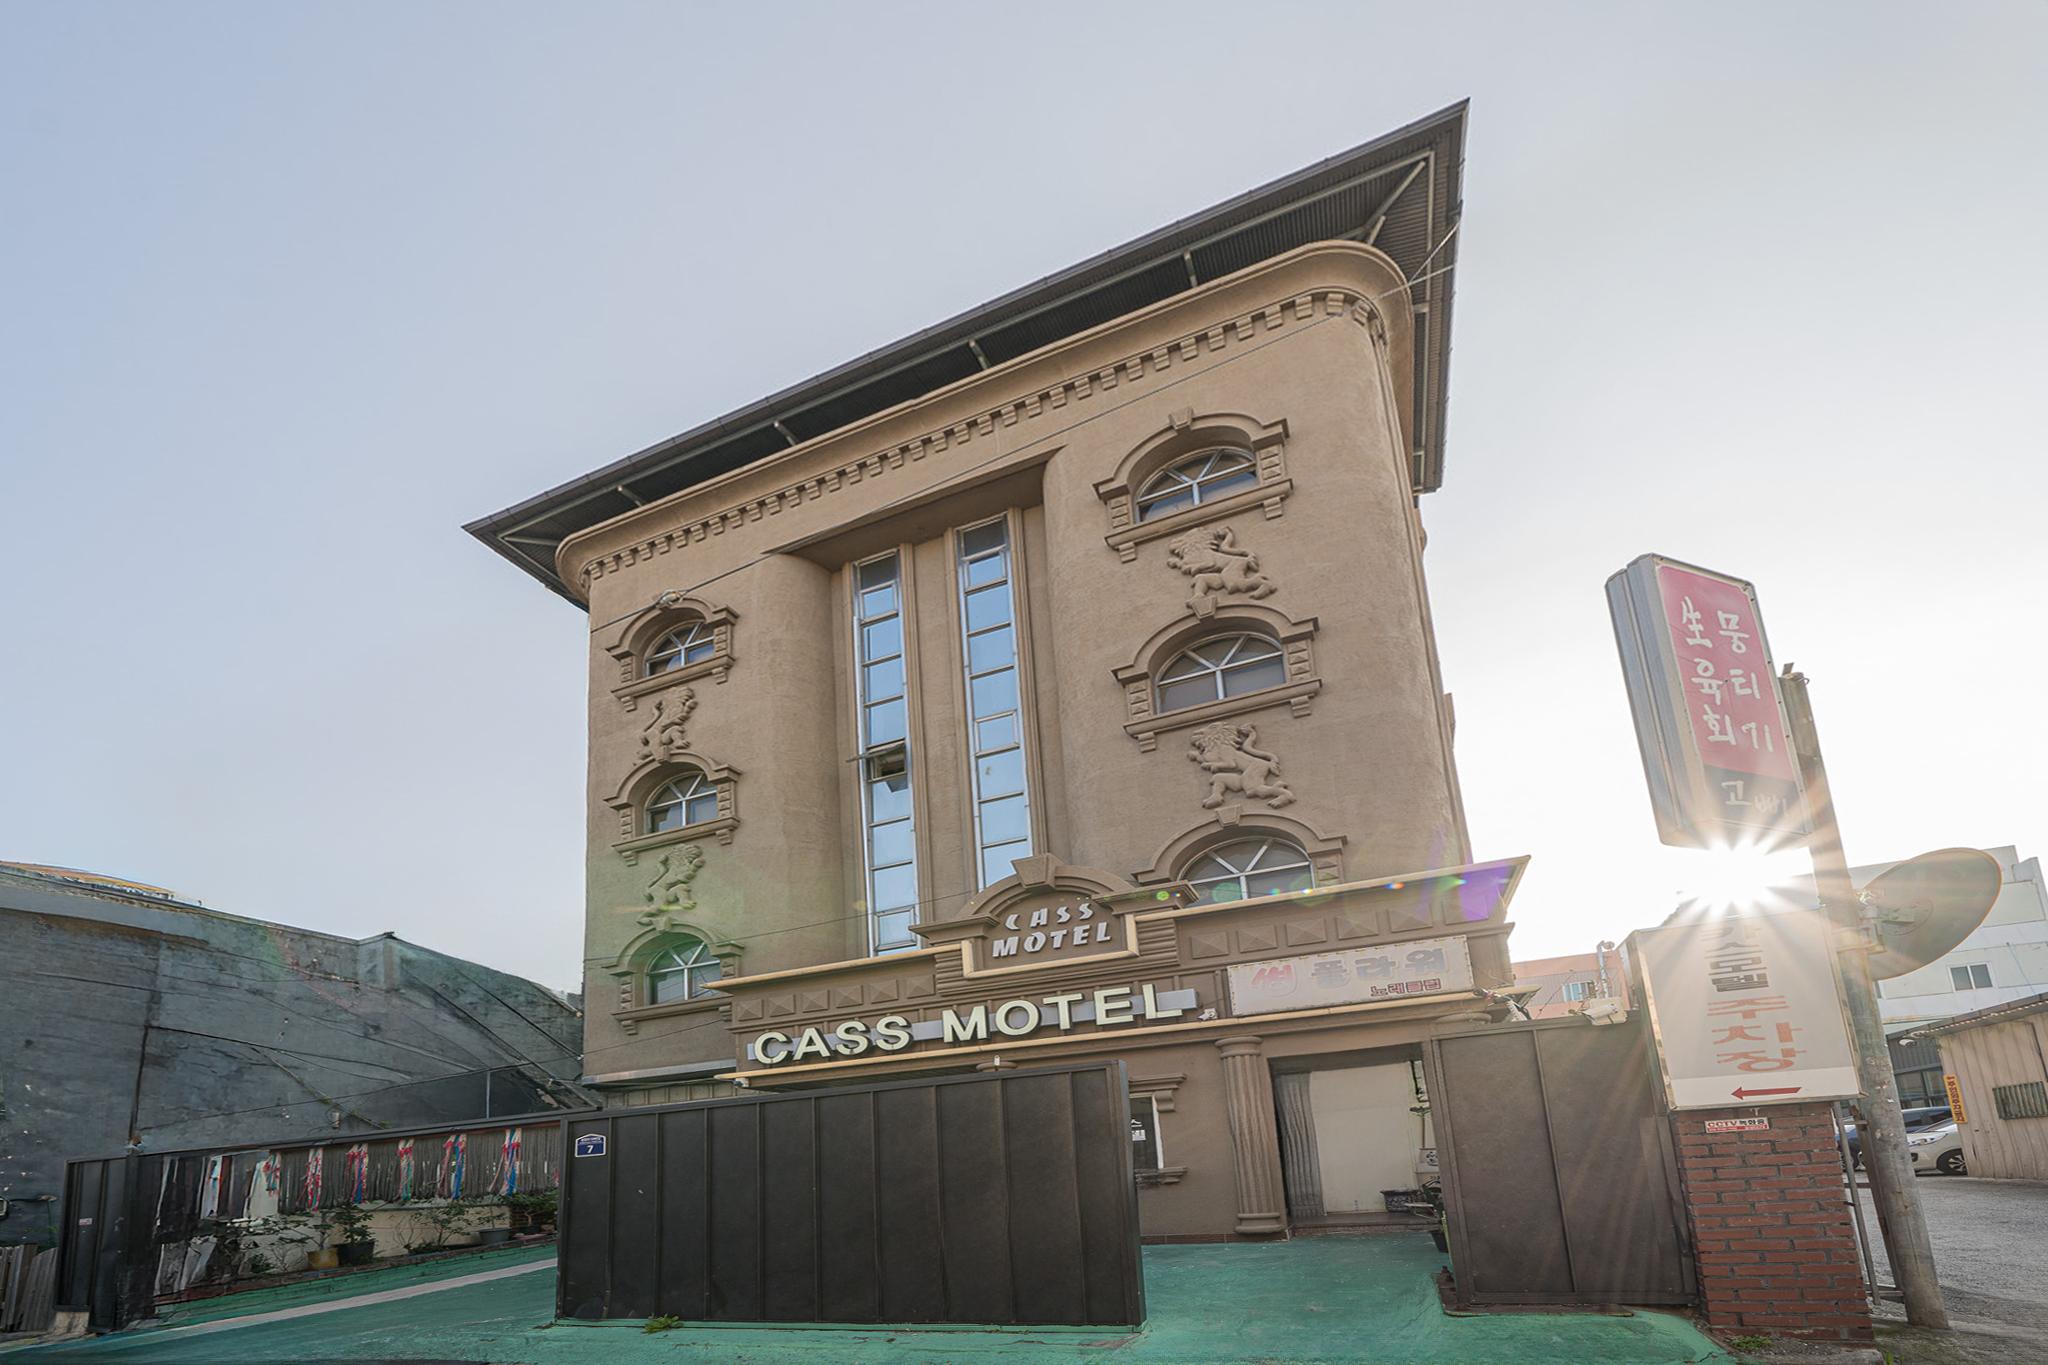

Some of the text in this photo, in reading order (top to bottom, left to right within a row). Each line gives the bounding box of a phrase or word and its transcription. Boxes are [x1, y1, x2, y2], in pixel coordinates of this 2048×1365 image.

[1718, 610, 1774, 753] 뭉티기
[1005, 902, 1095, 931] CASS
[992, 921, 1112, 958] MOTEL
[753, 983, 1184, 1065] CASS MOTEL
[1707, 995, 1807, 1073] 주차장
[1707, 1120, 1738, 1129] CCTV
[586, 1144, 594, 1154] 7
